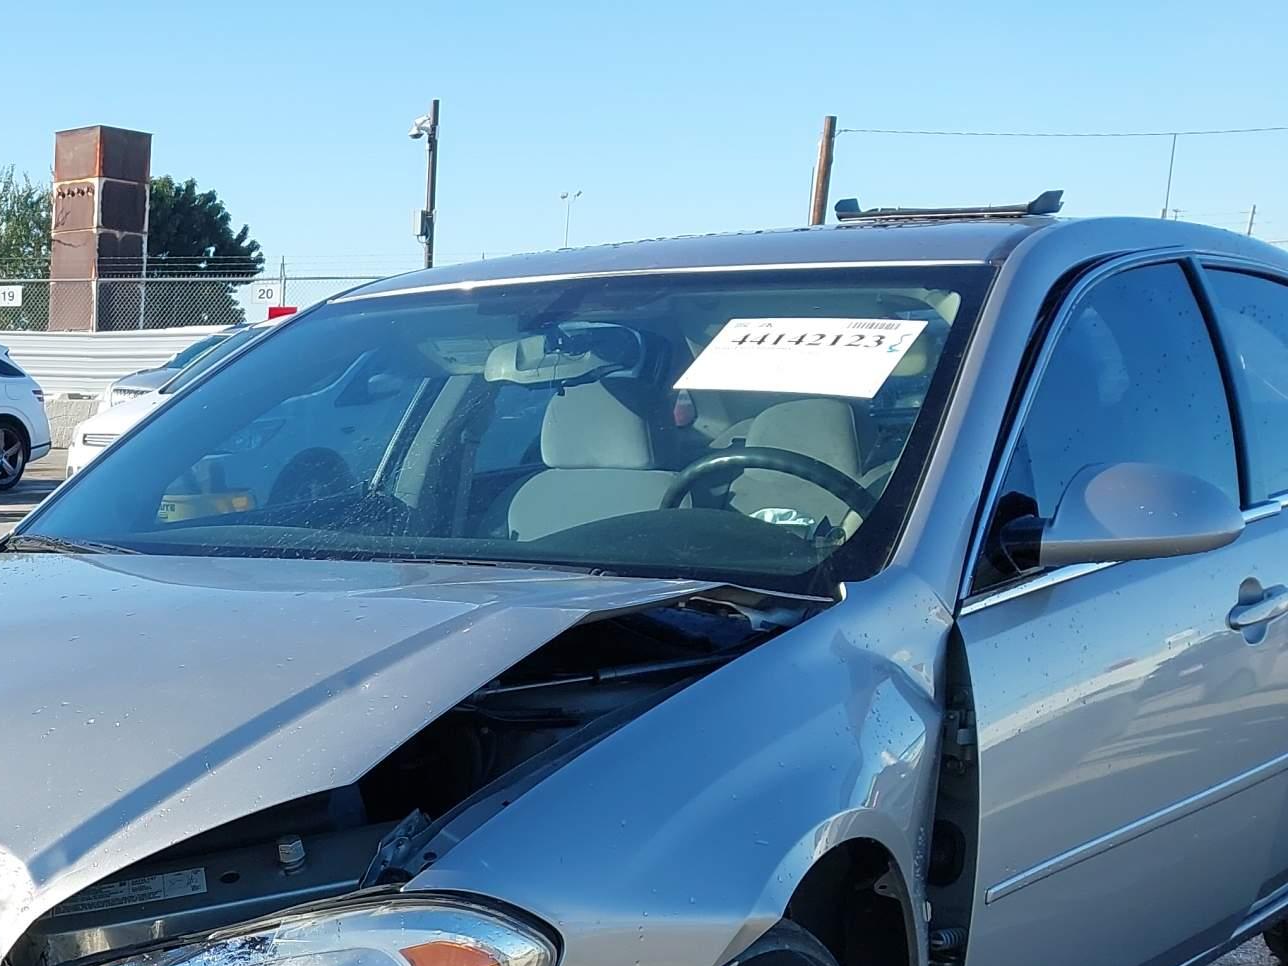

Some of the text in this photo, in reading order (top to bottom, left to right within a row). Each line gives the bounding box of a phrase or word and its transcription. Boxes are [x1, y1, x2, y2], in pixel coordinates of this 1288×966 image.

[0, 290, 15, 302] 19
[258, 288, 274, 299] 20
[731, 332, 886, 348] 44142123
